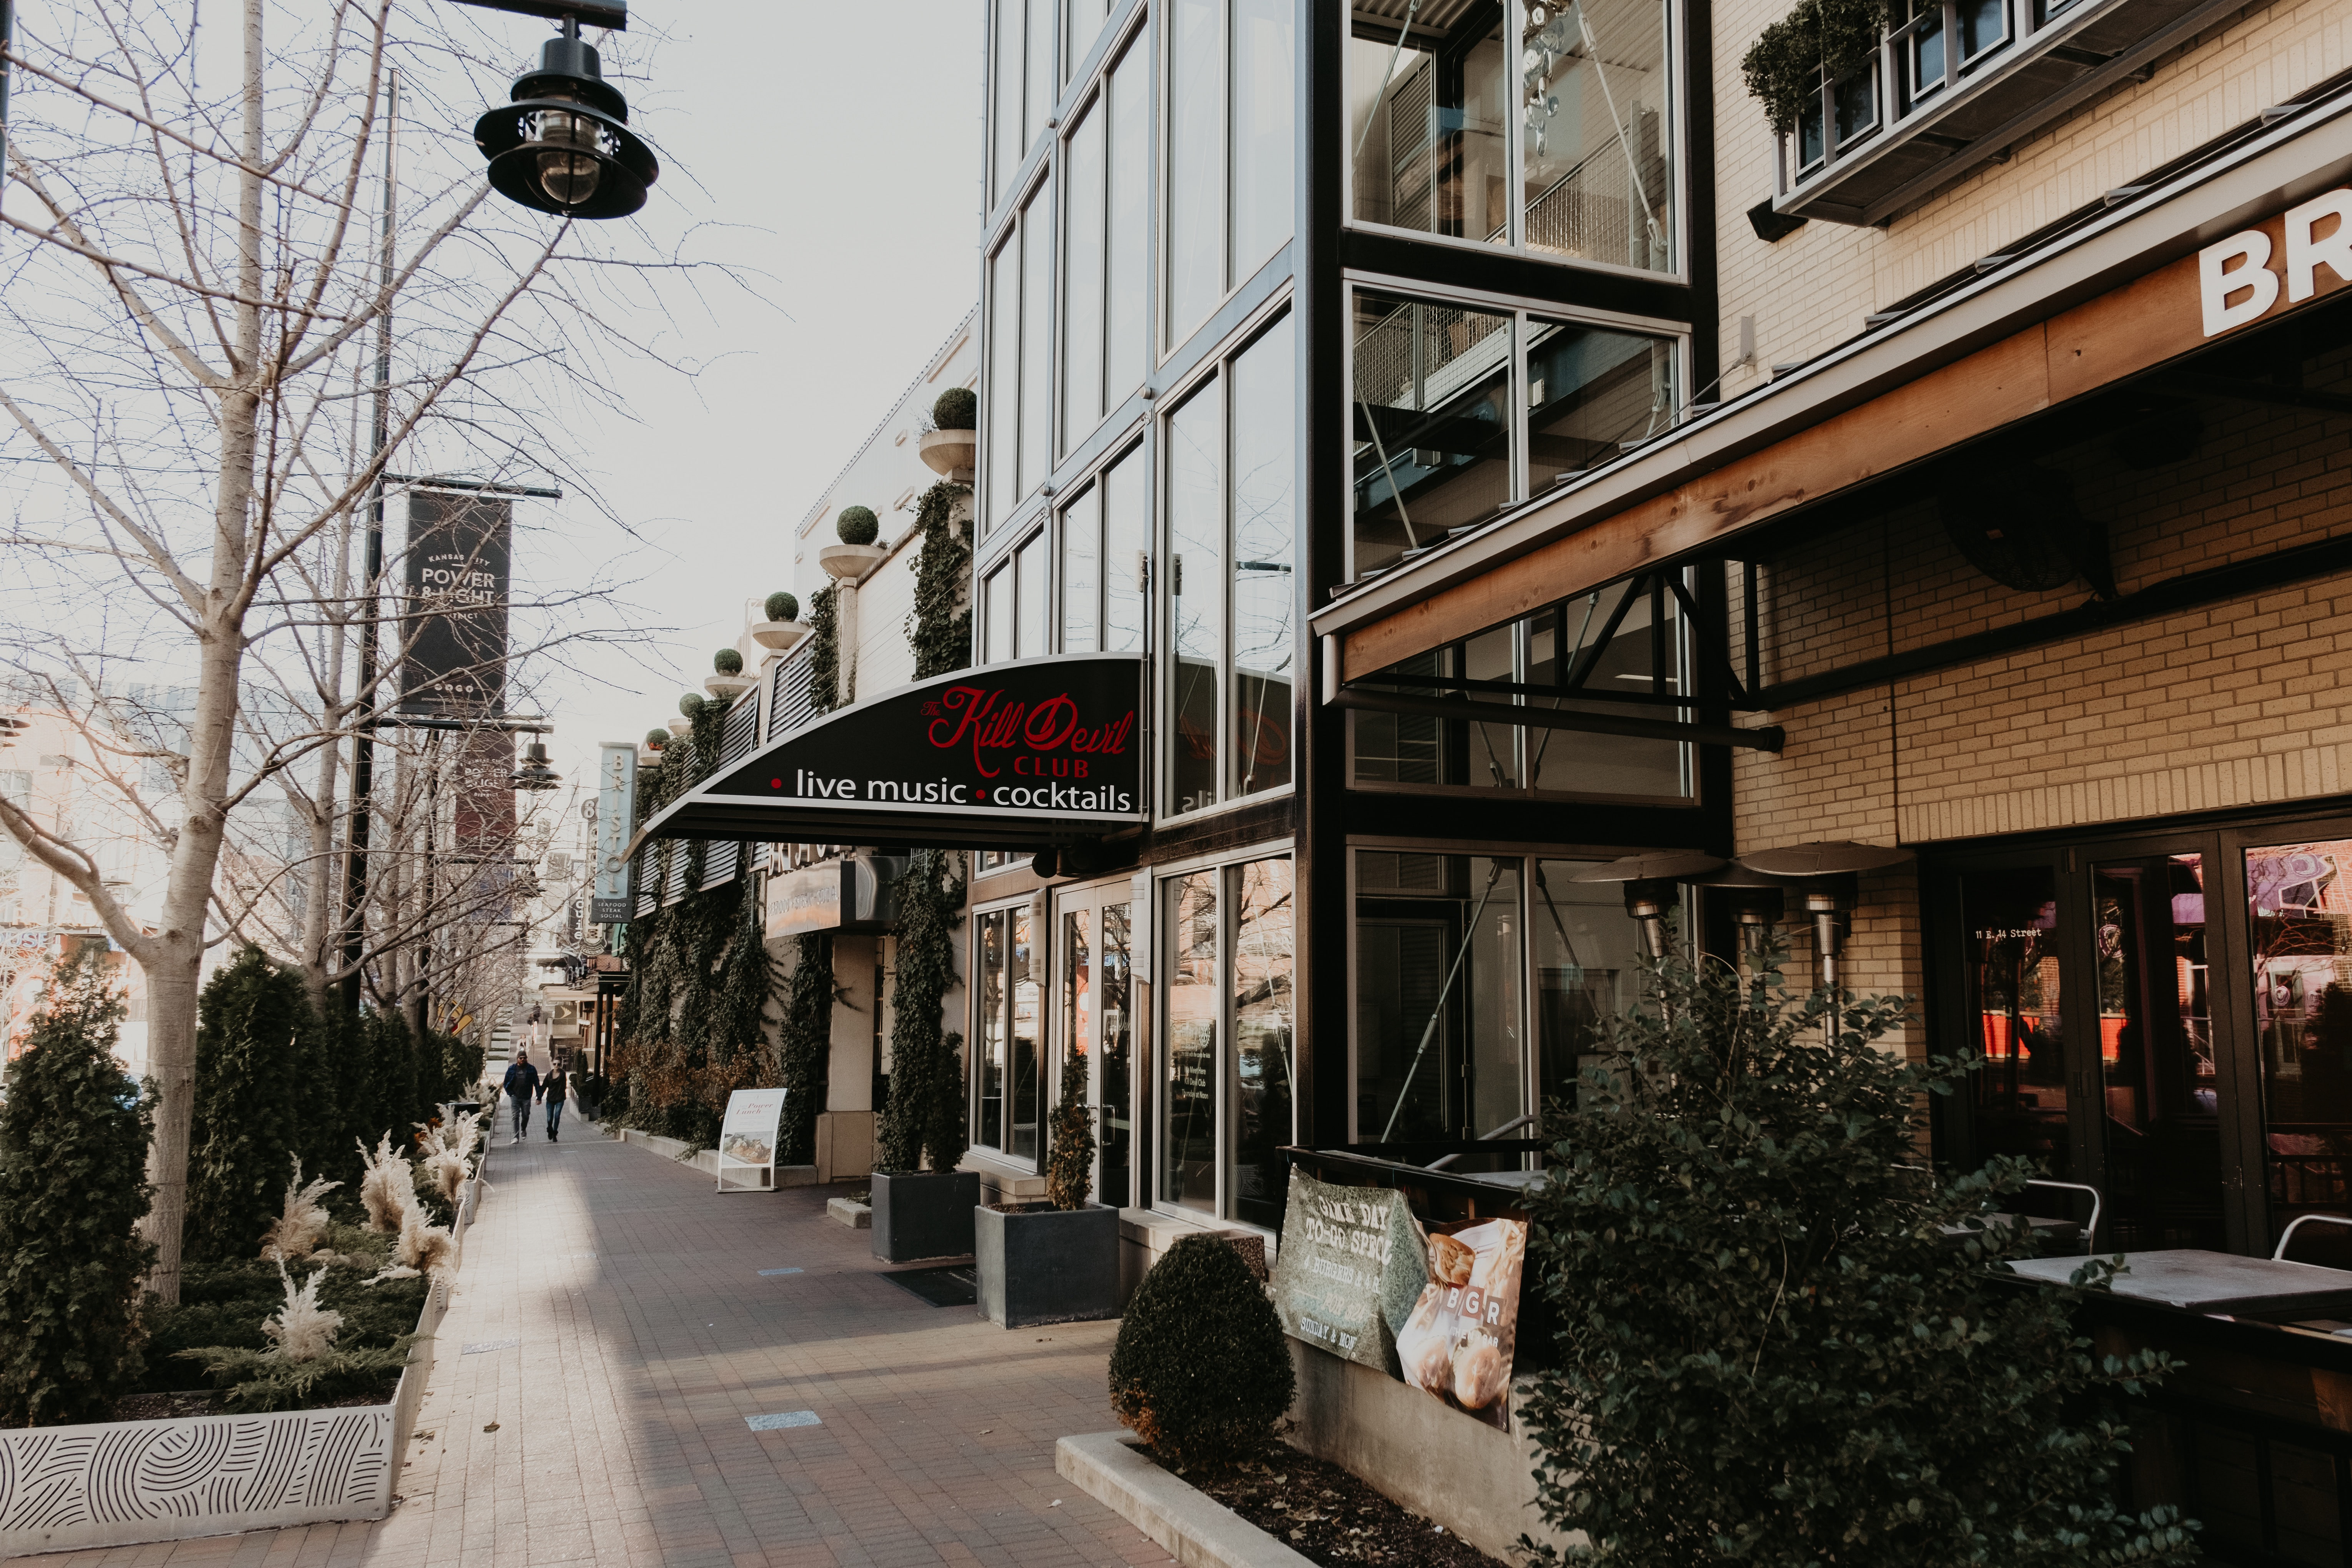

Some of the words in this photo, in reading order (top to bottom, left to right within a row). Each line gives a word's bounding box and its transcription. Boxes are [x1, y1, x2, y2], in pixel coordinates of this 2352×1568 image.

[2199, 188, 2352, 337] BR
[428, 554, 464, 562] KANSAS
[474, 557, 491, 566] ITY
[422, 568, 495, 588] POWER
[439, 587, 494, 604] GHT
[920, 701, 941, 716] The
[928, 686, 1024, 778] Kill
[1023, 693, 1134, 755] Devil
[464, 768, 508, 777] POER
[1014, 756, 1089, 778] CLUB
[797, 769, 856, 799] live
[868, 777, 966, 804] music
[993, 781, 1131, 812] cocktails
[604, 752, 625, 893] BRISTOL
[1976, 930, 1982, 939] 11
[1986, 931, 1994, 939] E.
[1998, 929, 2006, 939] 14
[2011, 928, 2042, 938] Street
[1190, 1078, 1198, 1086] Devil
[1198, 1067, 1206, 1075] Here
[1182, 1089, 1196, 1100] Thursday
[1199, 1091, 1208, 1099] Noon
[1359, 1203, 1388, 1231] DAY
[1306, 1217, 1346, 1250] TO-GO
[1312, 1256, 1355, 1284] BURGERS
[1355, 1270, 1362, 1287] &
[1365, 1273, 1370, 1290] 4
[1372, 1276, 1382, 1294] R
[1300, 1316, 1330, 1340] SUNDAY
[1330, 1329, 1337, 1343] &
[1339, 1332, 1357, 1350] MON
